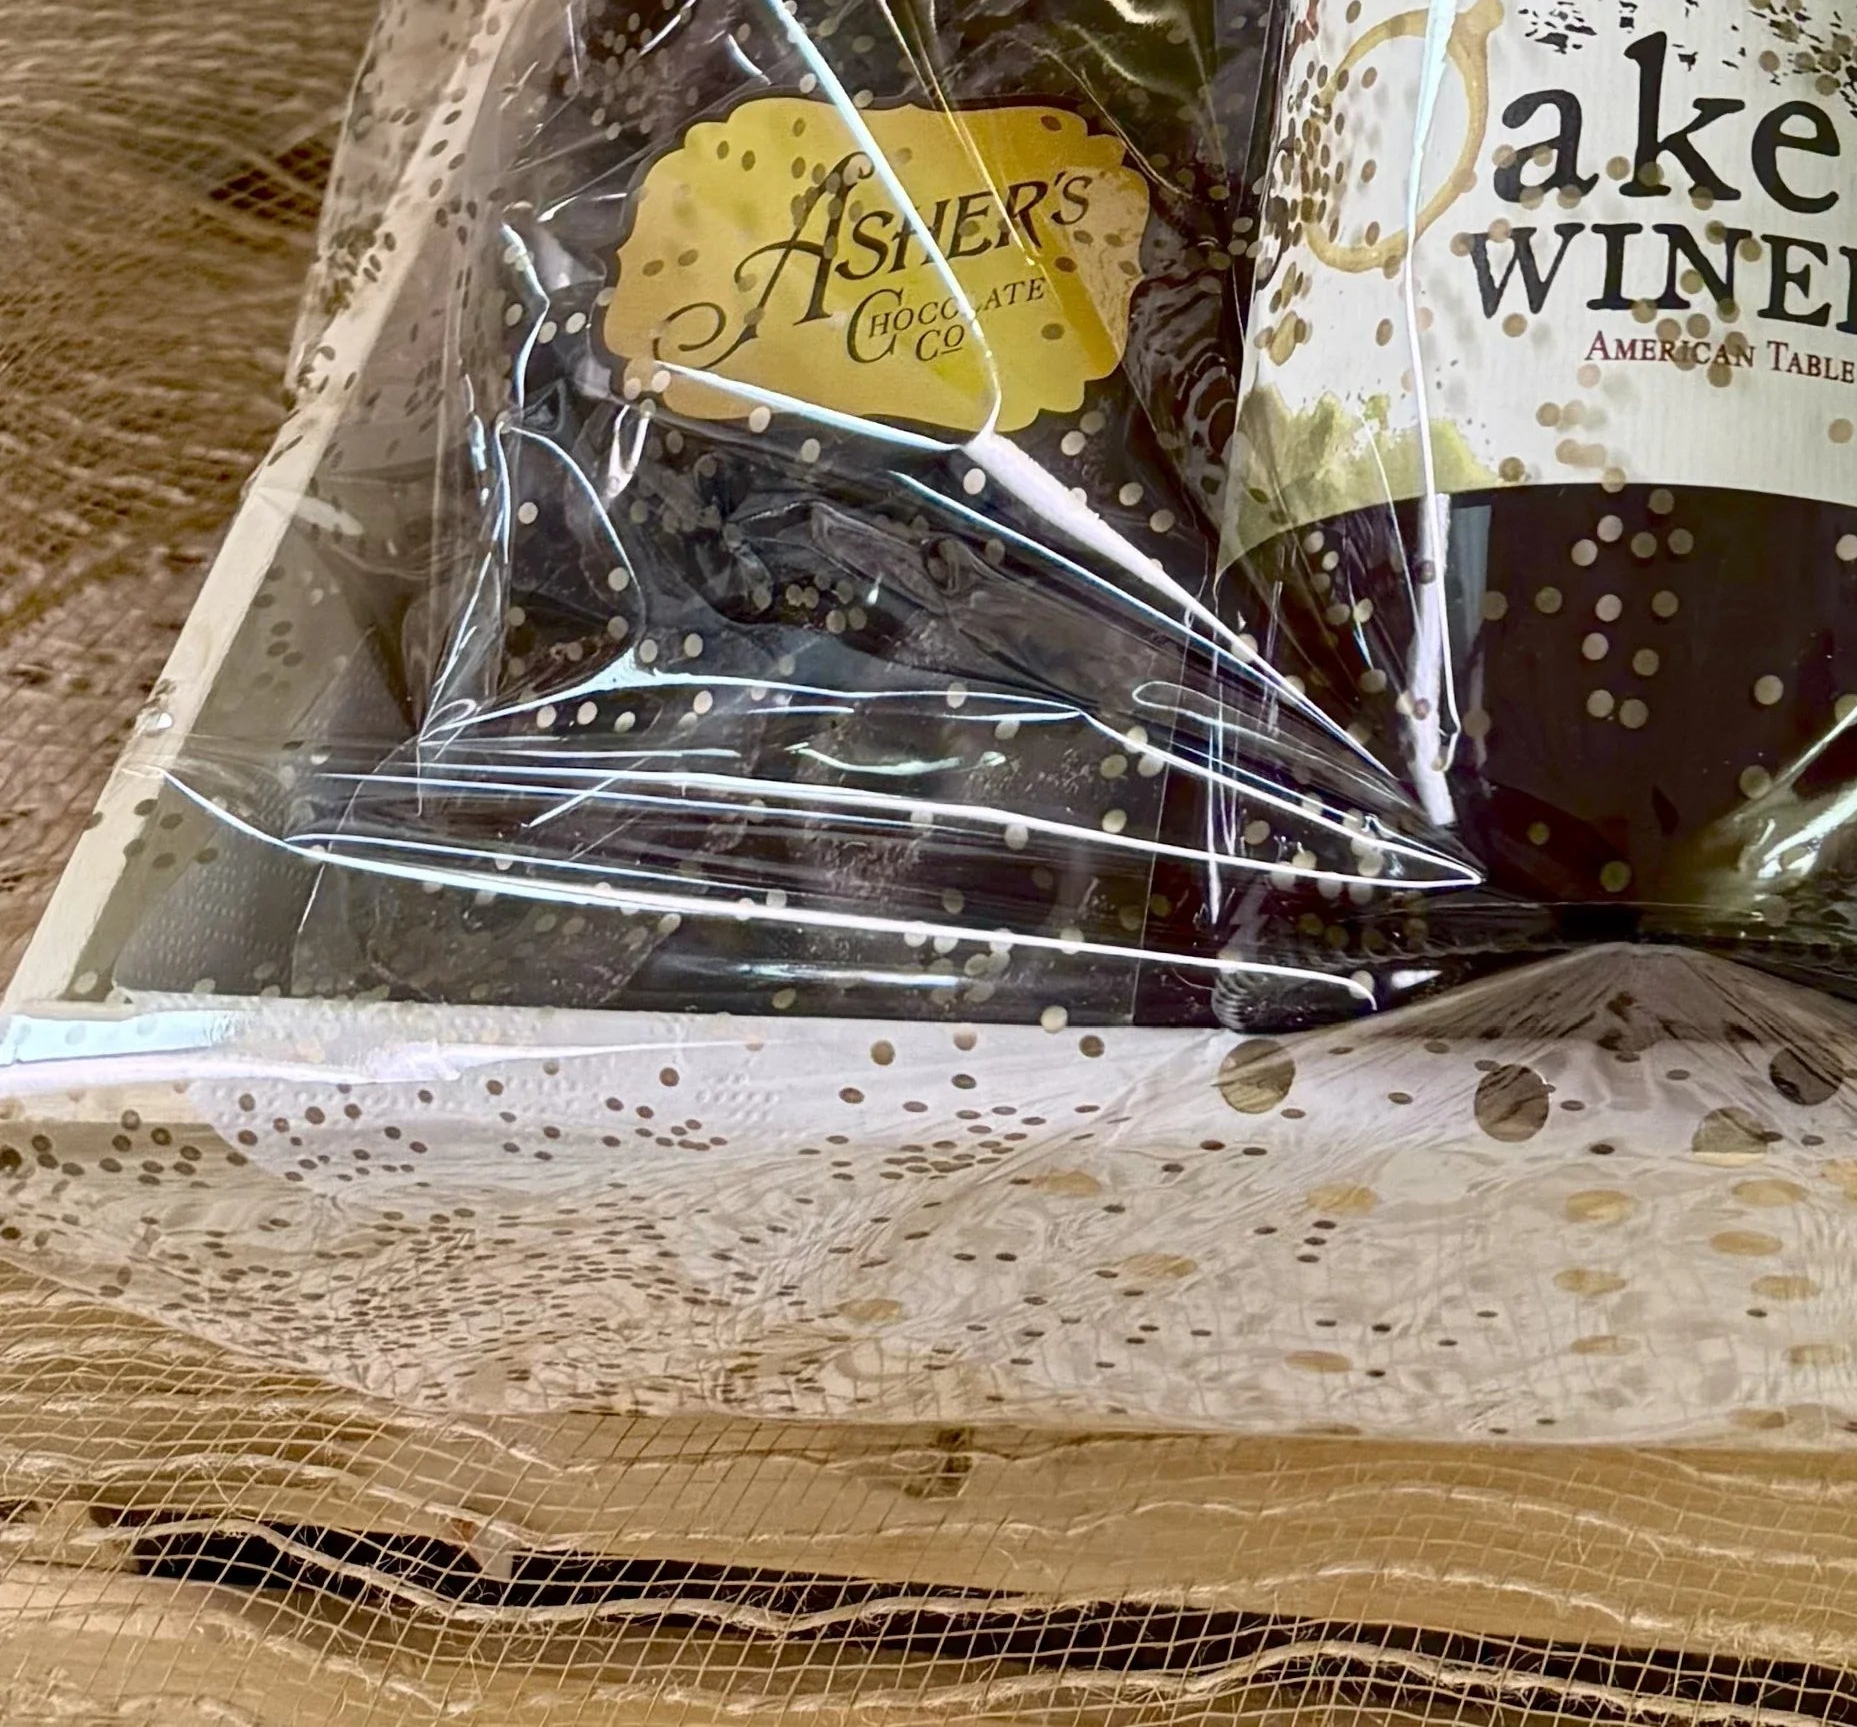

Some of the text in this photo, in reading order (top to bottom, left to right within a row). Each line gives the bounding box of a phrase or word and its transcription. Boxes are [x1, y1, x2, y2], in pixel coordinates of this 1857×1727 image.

[654, 150, 1093, 370] ASHER'S
[846, 276, 1046, 364] CHOCOATE
[1584, 329, 1755, 368] AMERICAN
